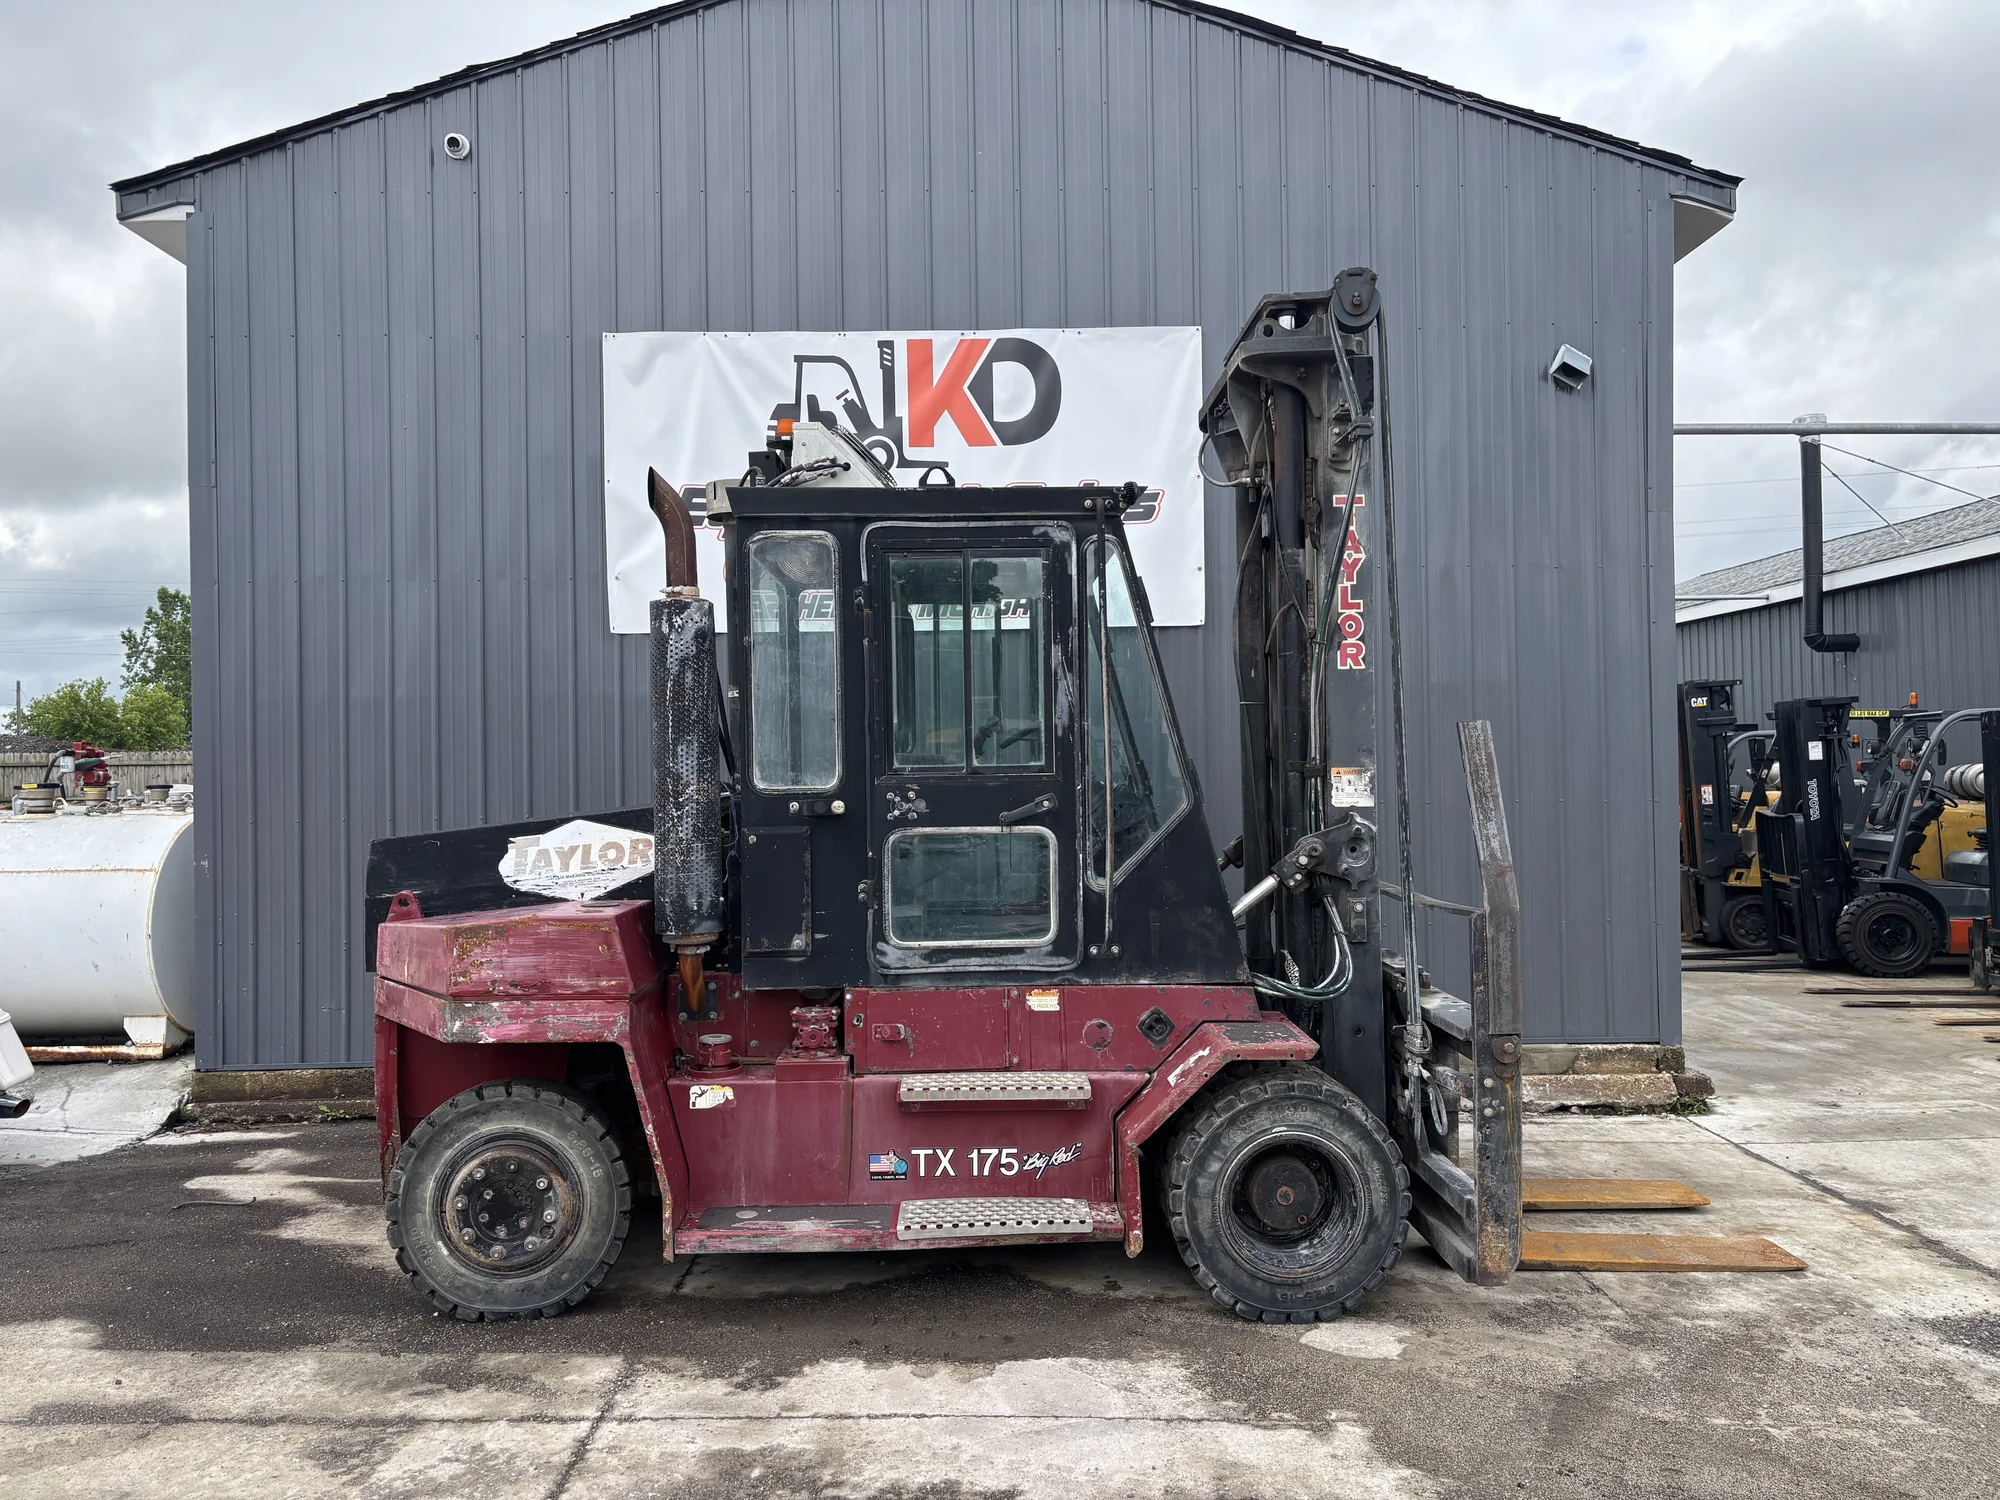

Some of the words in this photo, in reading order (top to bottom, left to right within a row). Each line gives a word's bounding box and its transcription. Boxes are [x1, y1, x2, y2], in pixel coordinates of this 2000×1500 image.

[907, 338, 1062, 447] KD
[1333, 494, 1366, 669] TAYLOR
[1690, 697, 1708, 707] CAT
[1807, 778, 1821, 821] TOYOTA
[513, 837, 654, 877] TAYLOR
[910, 1148, 958, 1178] TX
[967, 1148, 1020, 1178] 175
